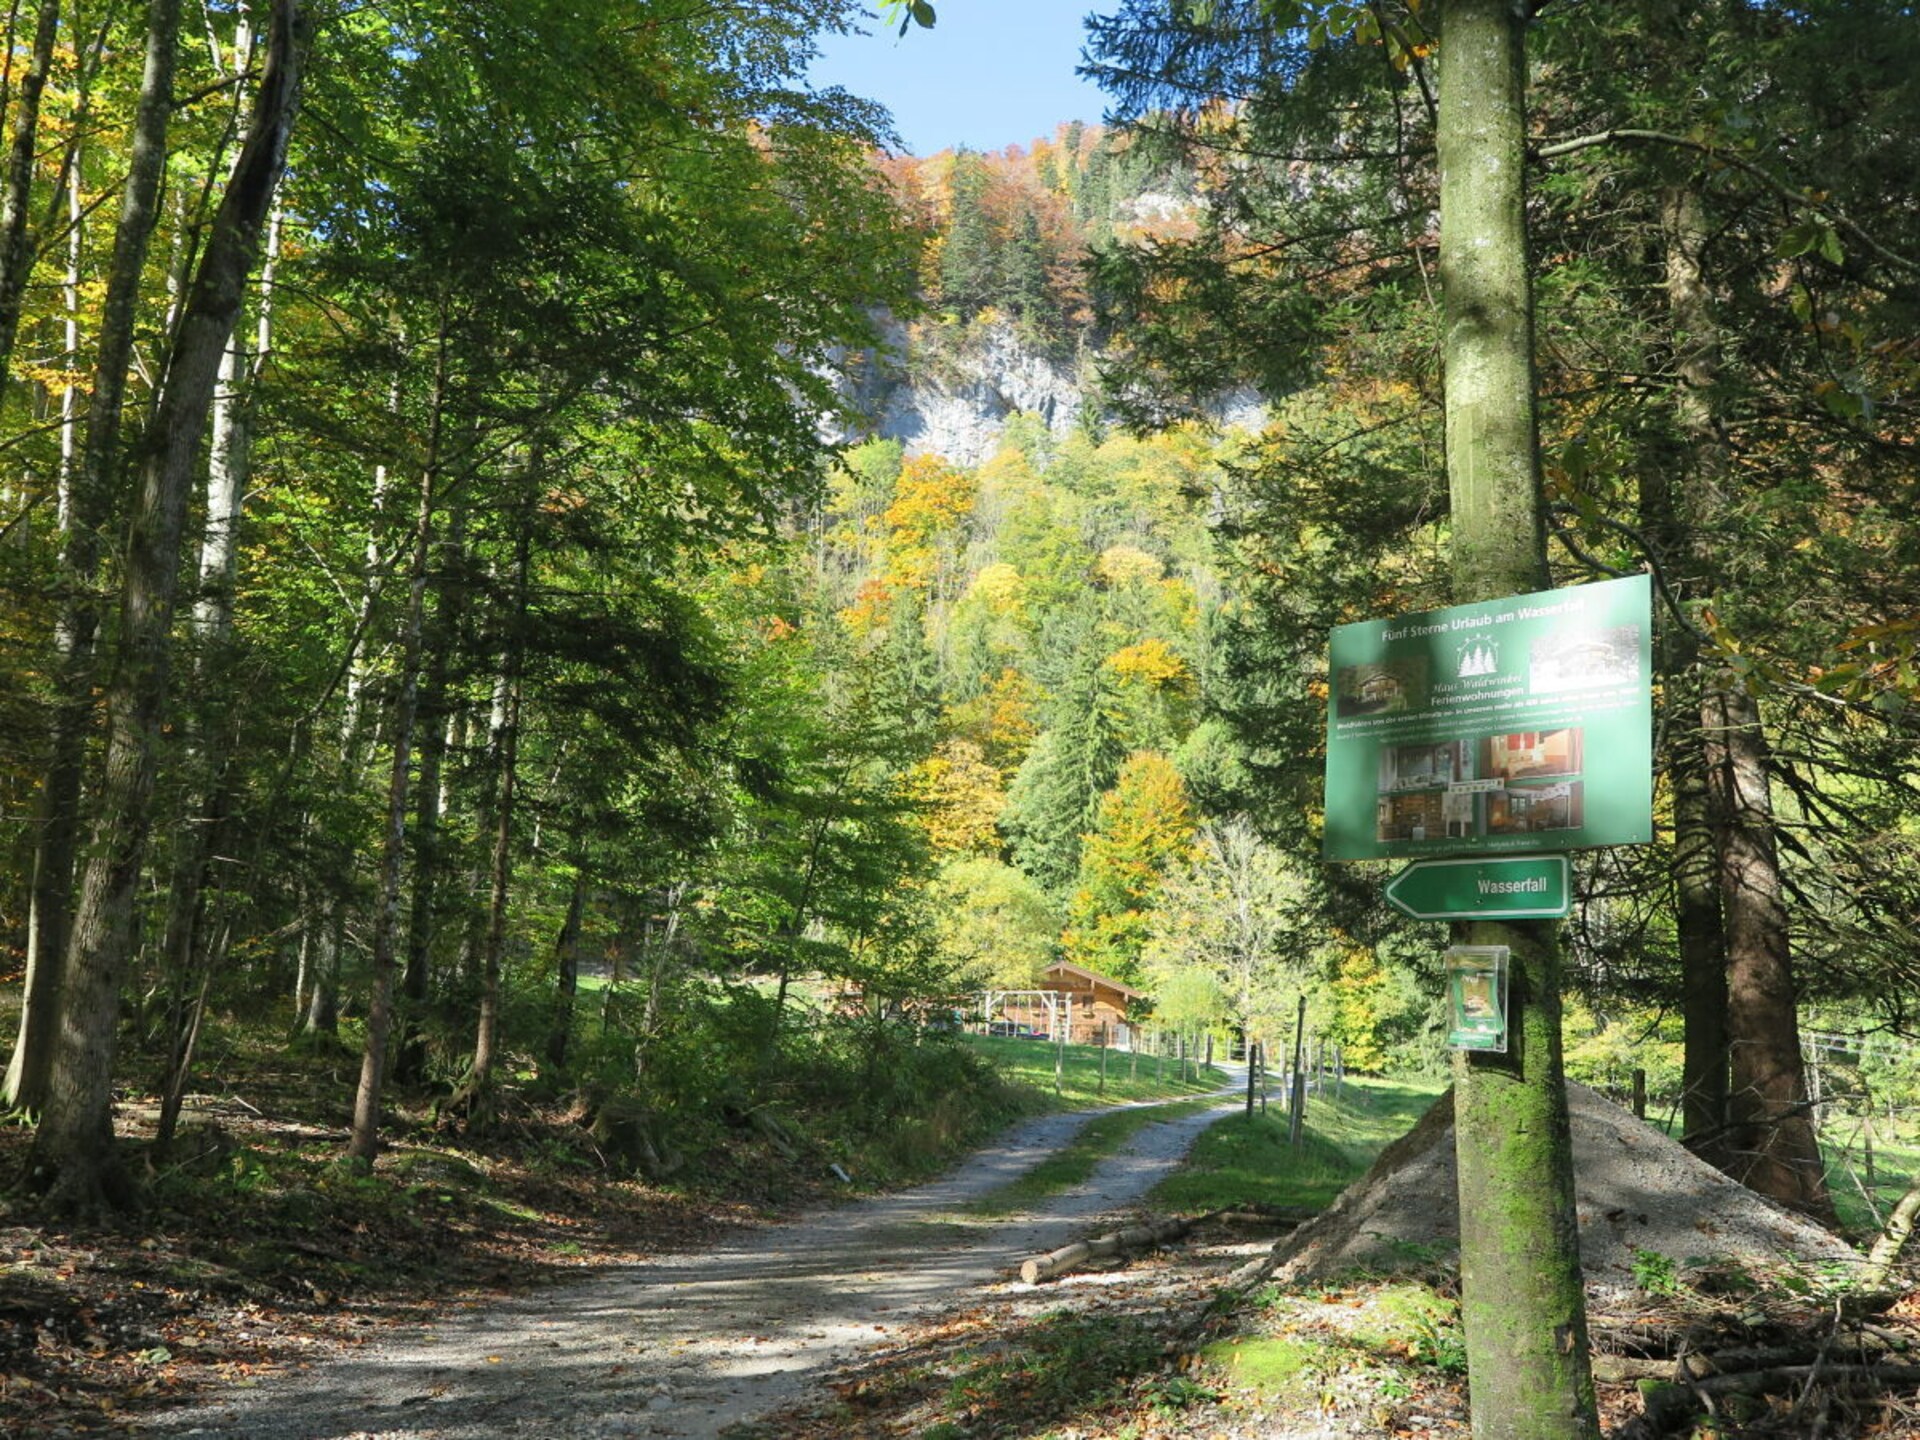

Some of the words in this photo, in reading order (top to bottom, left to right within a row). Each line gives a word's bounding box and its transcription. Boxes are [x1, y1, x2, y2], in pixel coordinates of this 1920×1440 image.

[1381, 628, 1409, 642] Fünf
[1411, 622, 1448, 637] Sterne
[1451, 614, 1493, 630] Urlaub
[1495, 612, 1515, 624] am
[1517, 600, 1585, 620] Wasserfall
[1430, 687, 1524, 706] Ferienwohnungen
[1477, 876, 1547, 894] Wasserfall
